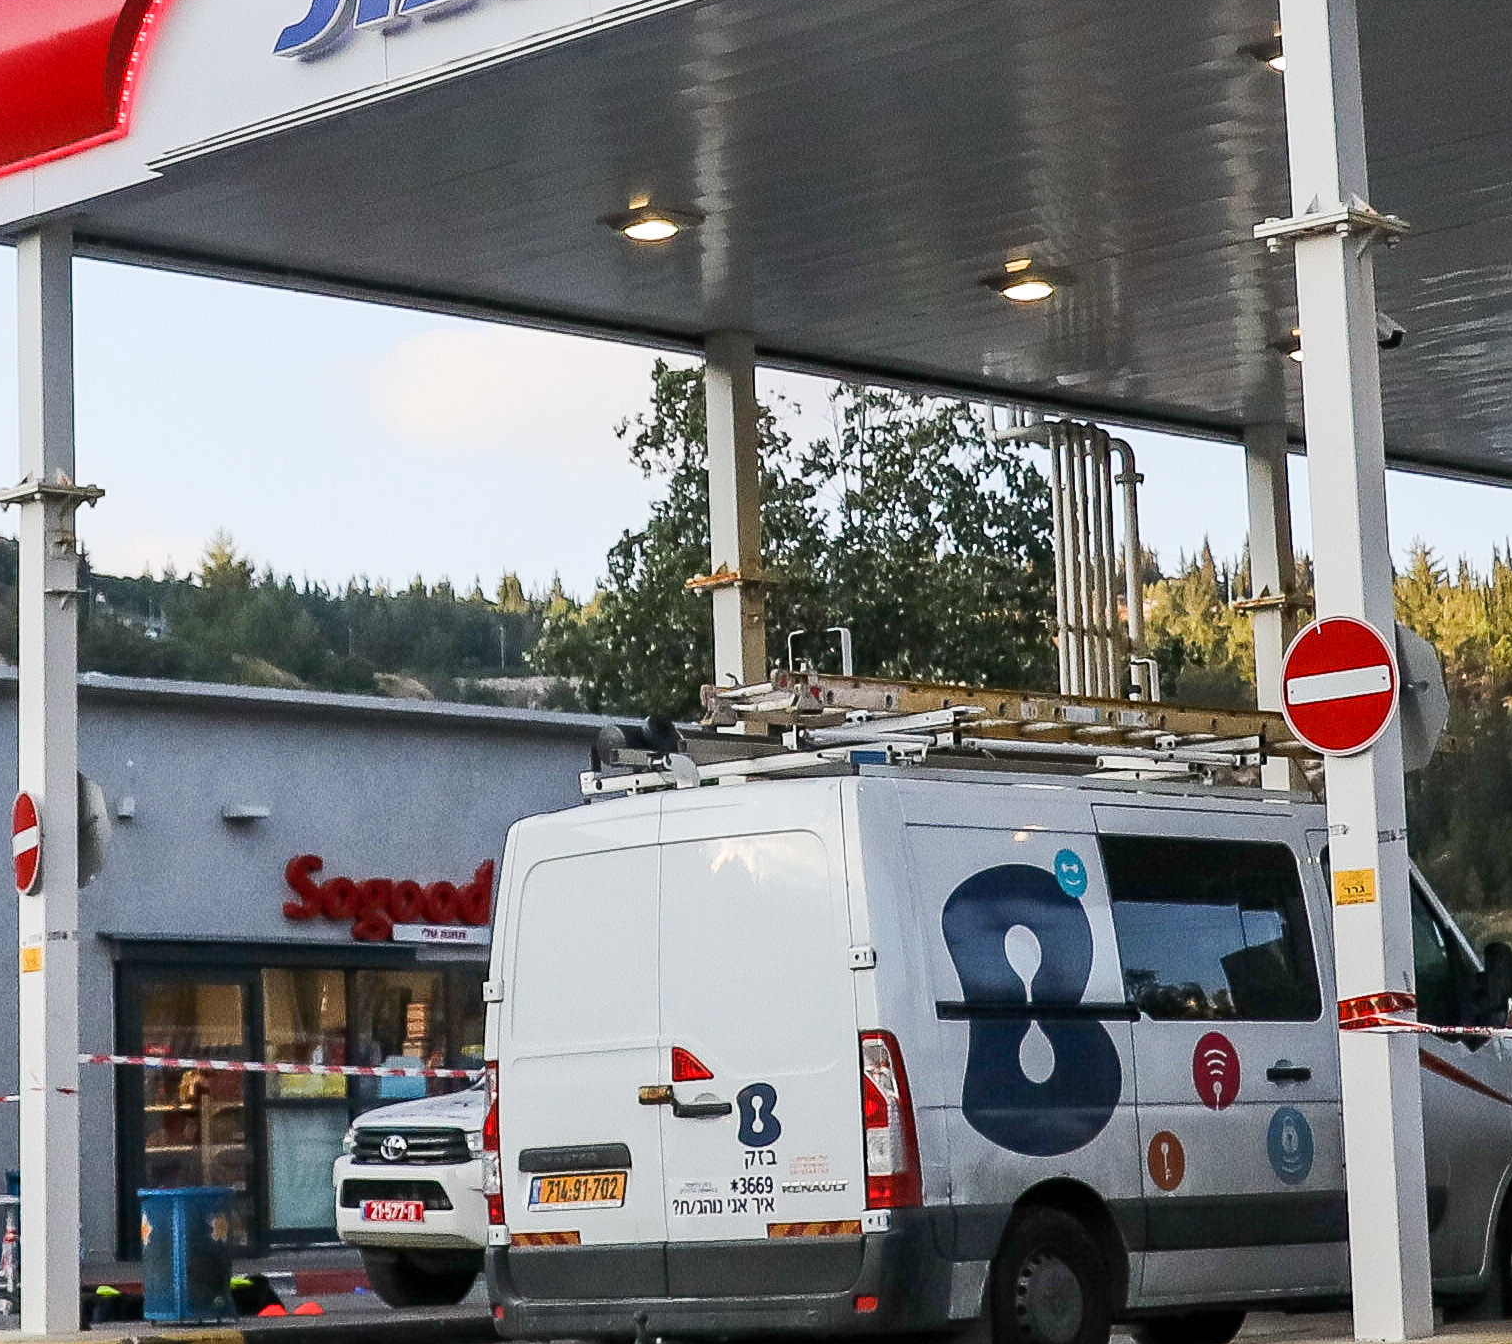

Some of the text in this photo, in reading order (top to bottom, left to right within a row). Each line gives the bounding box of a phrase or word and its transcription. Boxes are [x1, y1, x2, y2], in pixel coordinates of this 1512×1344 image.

[282, 854, 495, 941] Sogood
[744, 1149, 777, 1170] בזק
[781, 1179, 849, 1193] RENAULT
[726, 1198, 748, 1214] אני
[751, 1197, 775, 1215] איך
